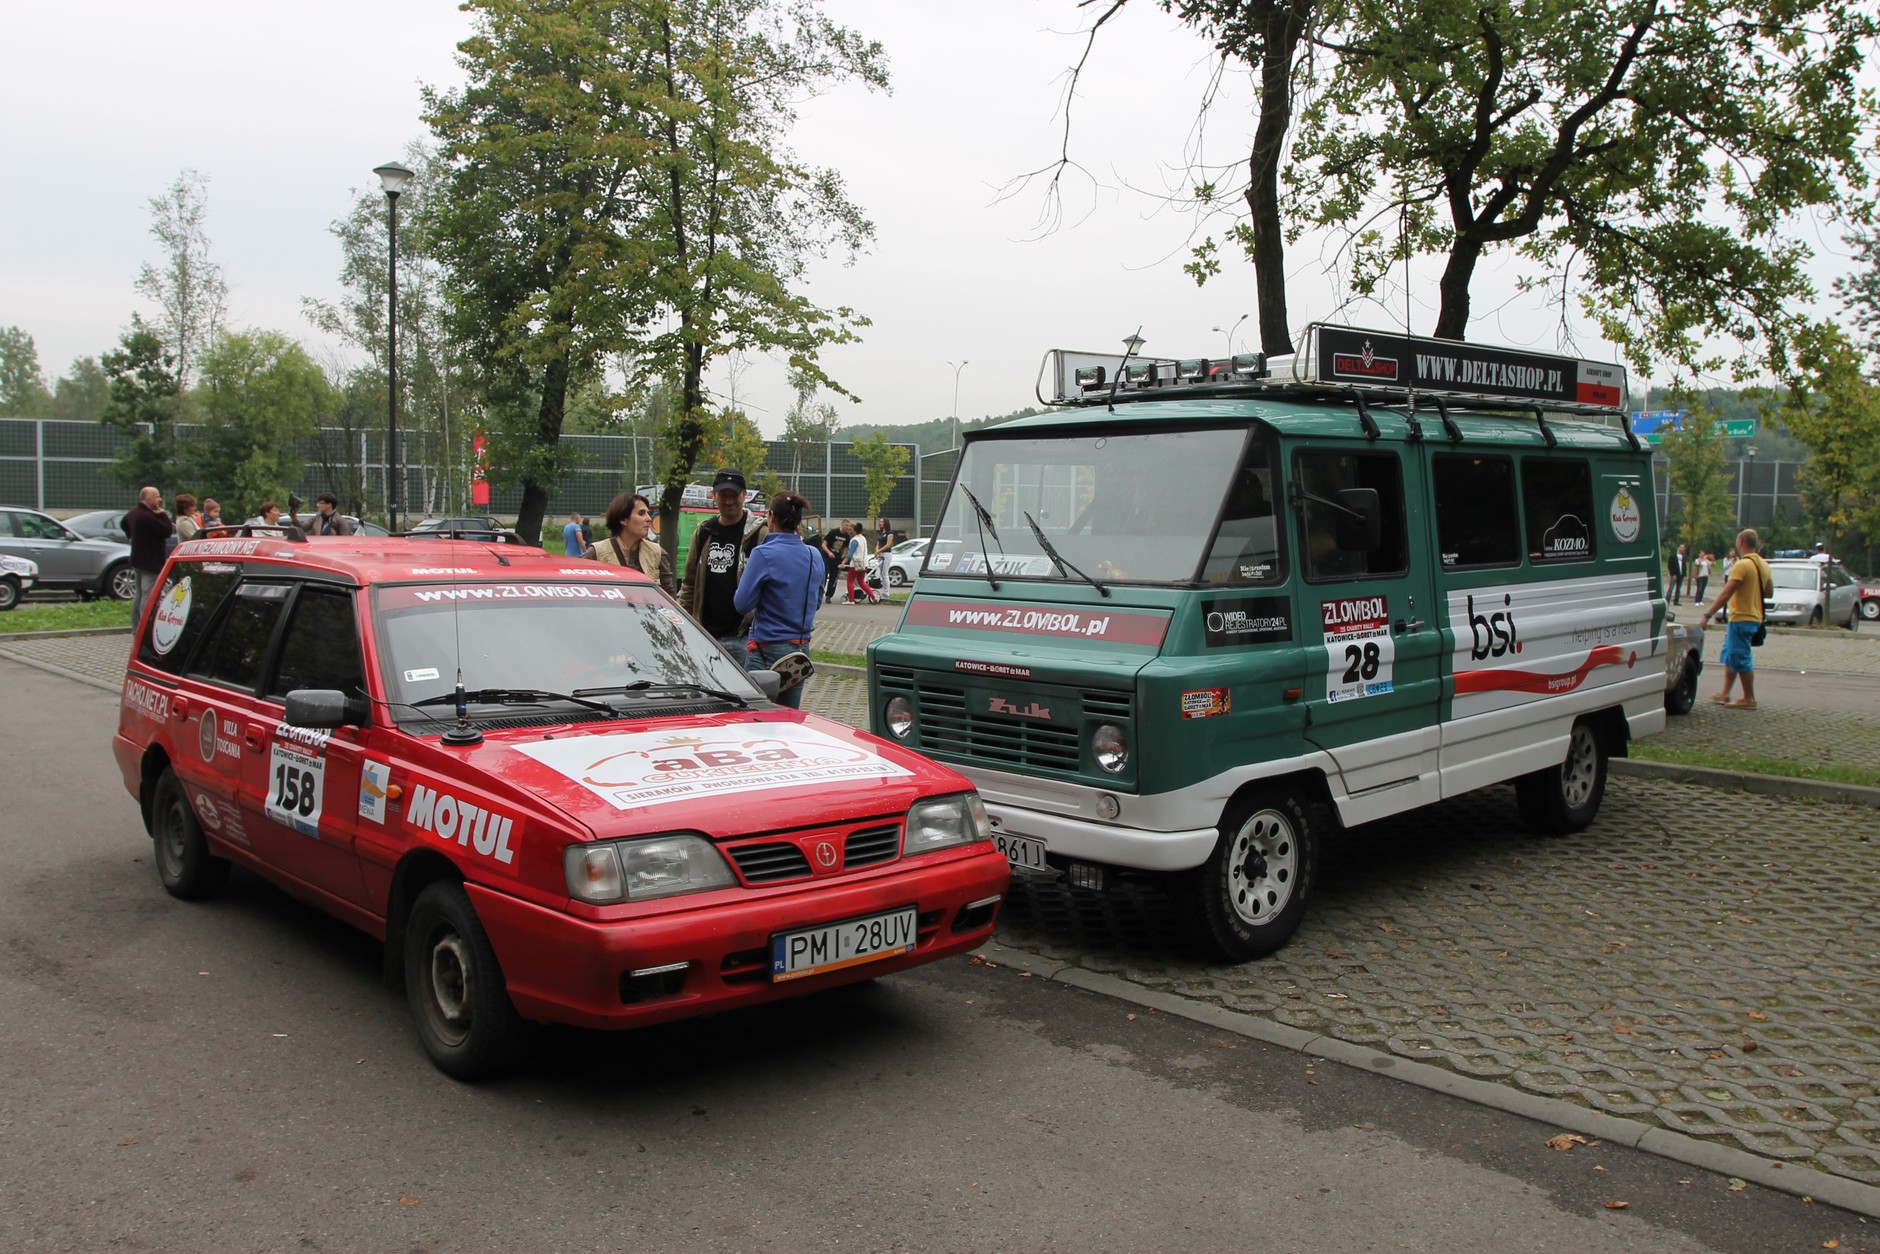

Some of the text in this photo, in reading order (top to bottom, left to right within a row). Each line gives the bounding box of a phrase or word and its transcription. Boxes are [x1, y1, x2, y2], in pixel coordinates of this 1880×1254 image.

[1416, 354, 1564, 392] WWW.DELTASHOP.PL
[1554, 537, 1586, 551] KOZMO
[411, 567, 478, 575] MOTUL
[559, 568, 615, 576] MOTUL
[1224, 611, 1247, 621] WIDEO
[1363, 622, 1375, 630] RALLY
[1016, 668, 1031, 676] MAR
[1342, 641, 1380, 684] 28
[127, 679, 169, 718] TACHO.NET.PL
[223, 719, 238, 737] VILLA
[217, 738, 241, 759] TOSCANIA
[275, 763, 315, 818] 158
[626, 785, 694, 800] SIERAKÓW
[702, 776, 775, 789] DWORCOWA
[801, 771, 827, 779] TEL.
[407, 784, 514, 865] MOTUL
[991, 834, 1040, 867] 861J
[791, 913, 912, 969] PMI 28UV
[774, 960, 785, 970] PL
